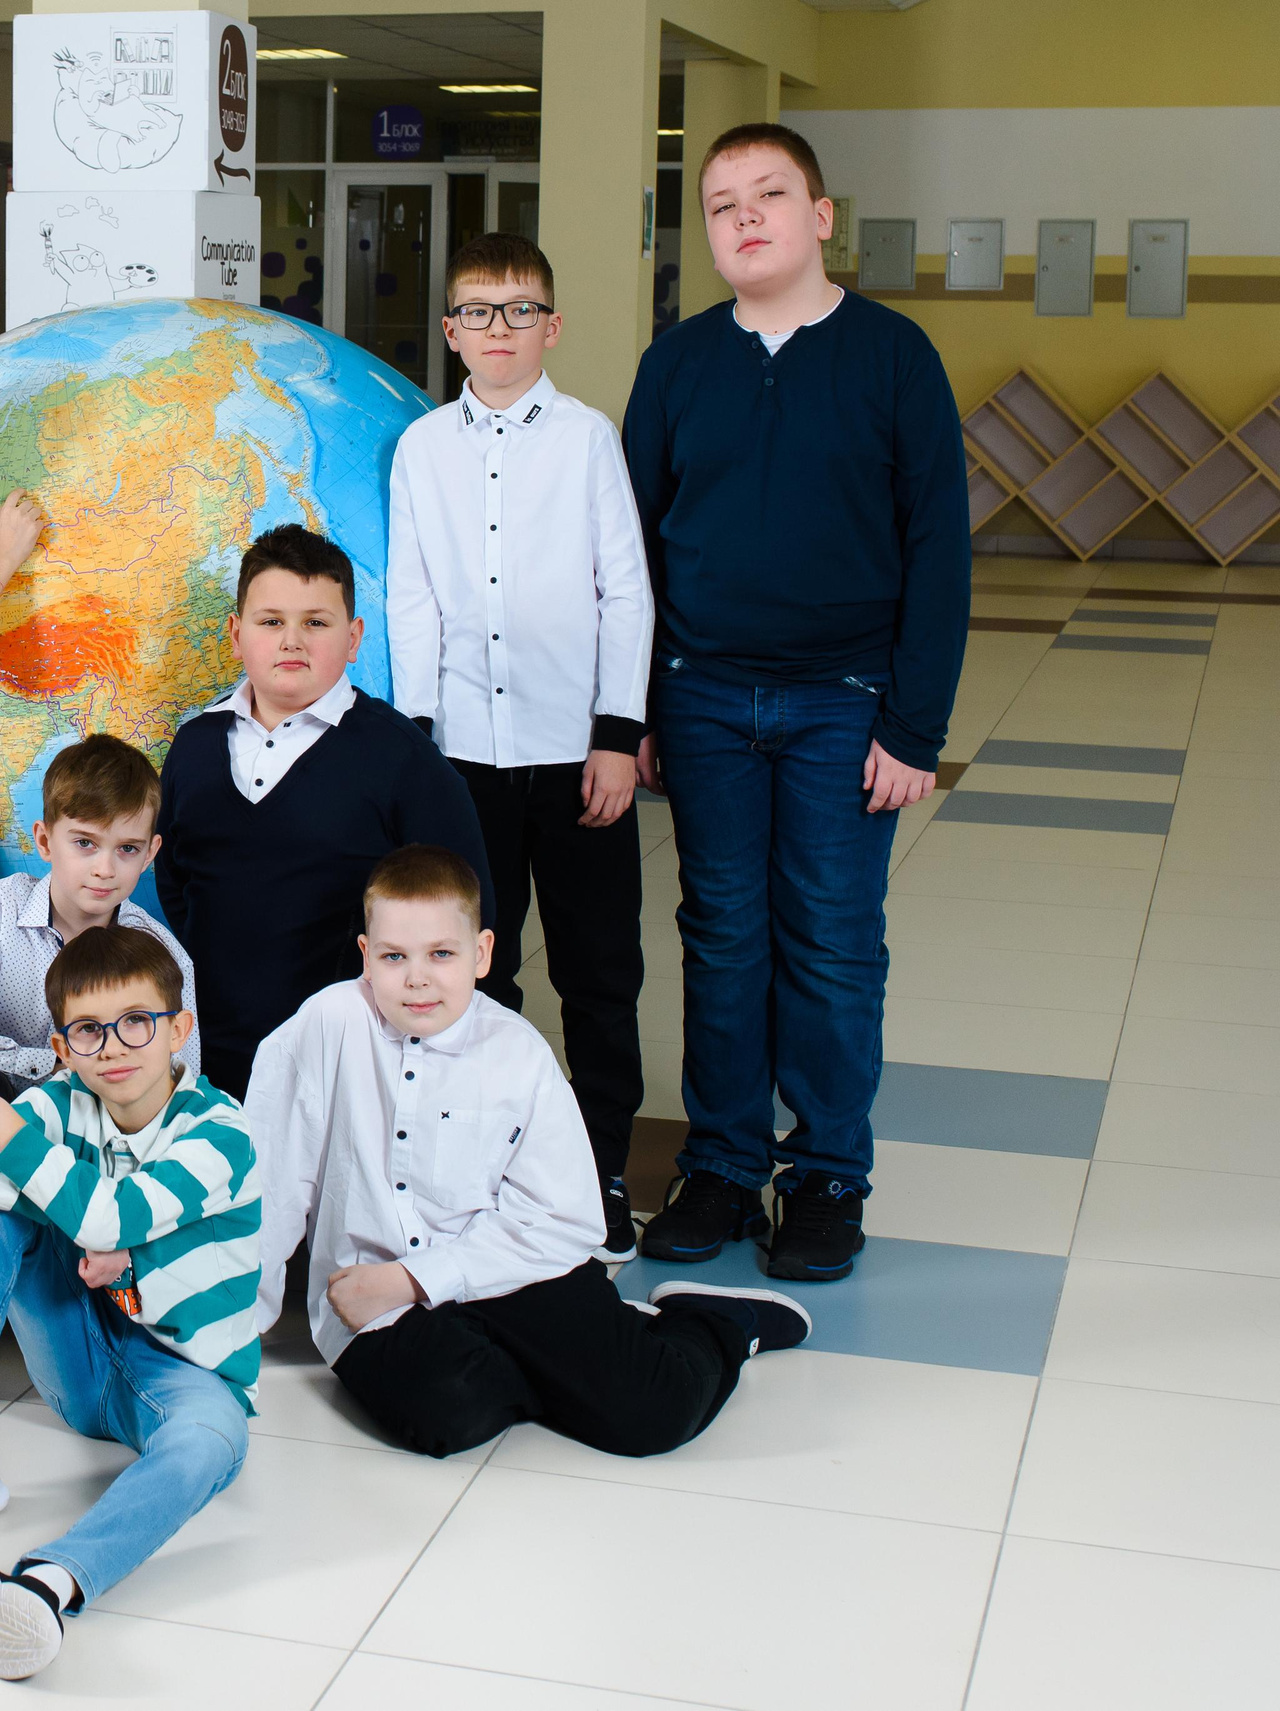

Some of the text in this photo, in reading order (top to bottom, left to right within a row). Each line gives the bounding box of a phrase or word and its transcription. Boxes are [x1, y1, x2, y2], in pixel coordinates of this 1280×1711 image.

[222, 39, 246, 100] 2 БЛОК
[379, 110, 421, 138] 1 БЛОК
[202, 236, 255, 262] Communication
[220, 261, 237, 286] Tube
